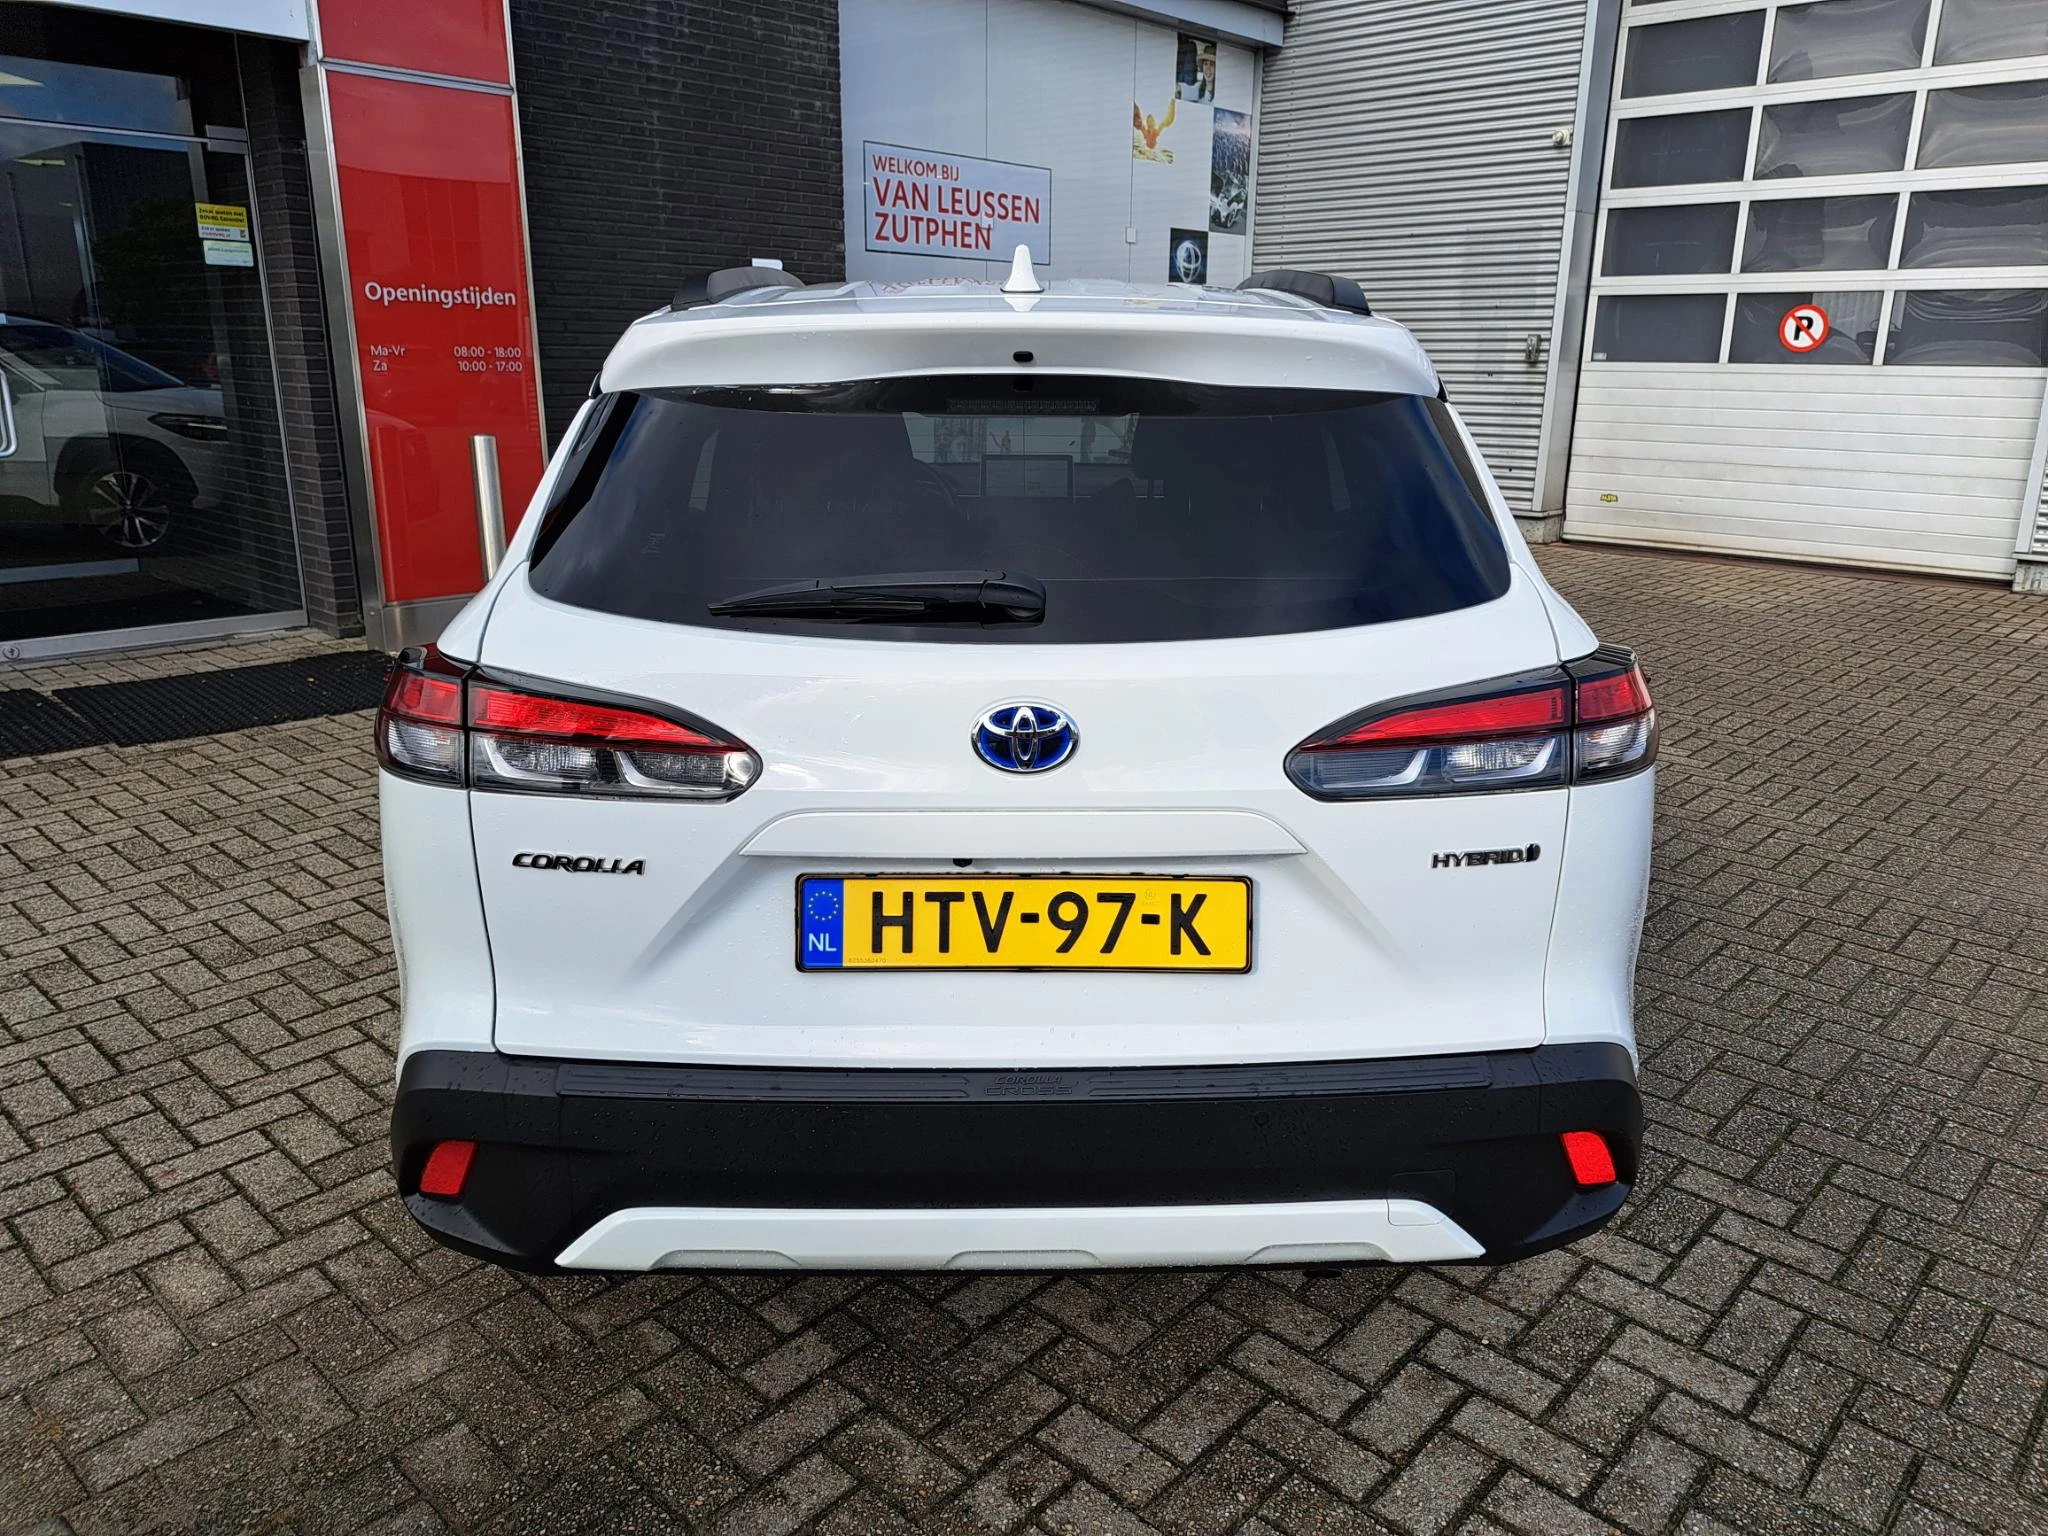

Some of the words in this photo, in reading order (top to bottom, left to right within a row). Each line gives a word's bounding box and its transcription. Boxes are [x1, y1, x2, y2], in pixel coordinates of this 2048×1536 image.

[872, 154, 938, 179] WELKOM
[941, 164, 960, 182] BIJ
[873, 176, 930, 212] VAN
[937, 185, 1041, 225] LEUSSEN
[874, 212, 993, 250] ZUTPHEN
[365, 282, 516, 309] Openingstijden
[1793, 316, 1814, 341] P
[370, 345, 406, 357] Ma-Vr
[454, 346, 485, 358] 08:00
[495, 347, 521, 358] 18:00
[373, 360, 388, 372] Za
[458, 361, 486, 372] 10:00
[496, 361, 523, 372] 17:00
[512, 852, 647, 876] COROLLA
[1431, 849, 1524, 868] HYBRID
[871, 891, 1211, 955] HTV-97-K
[808, 933, 837, 951] NL
[984, 1086, 1073, 1096] CROSS
